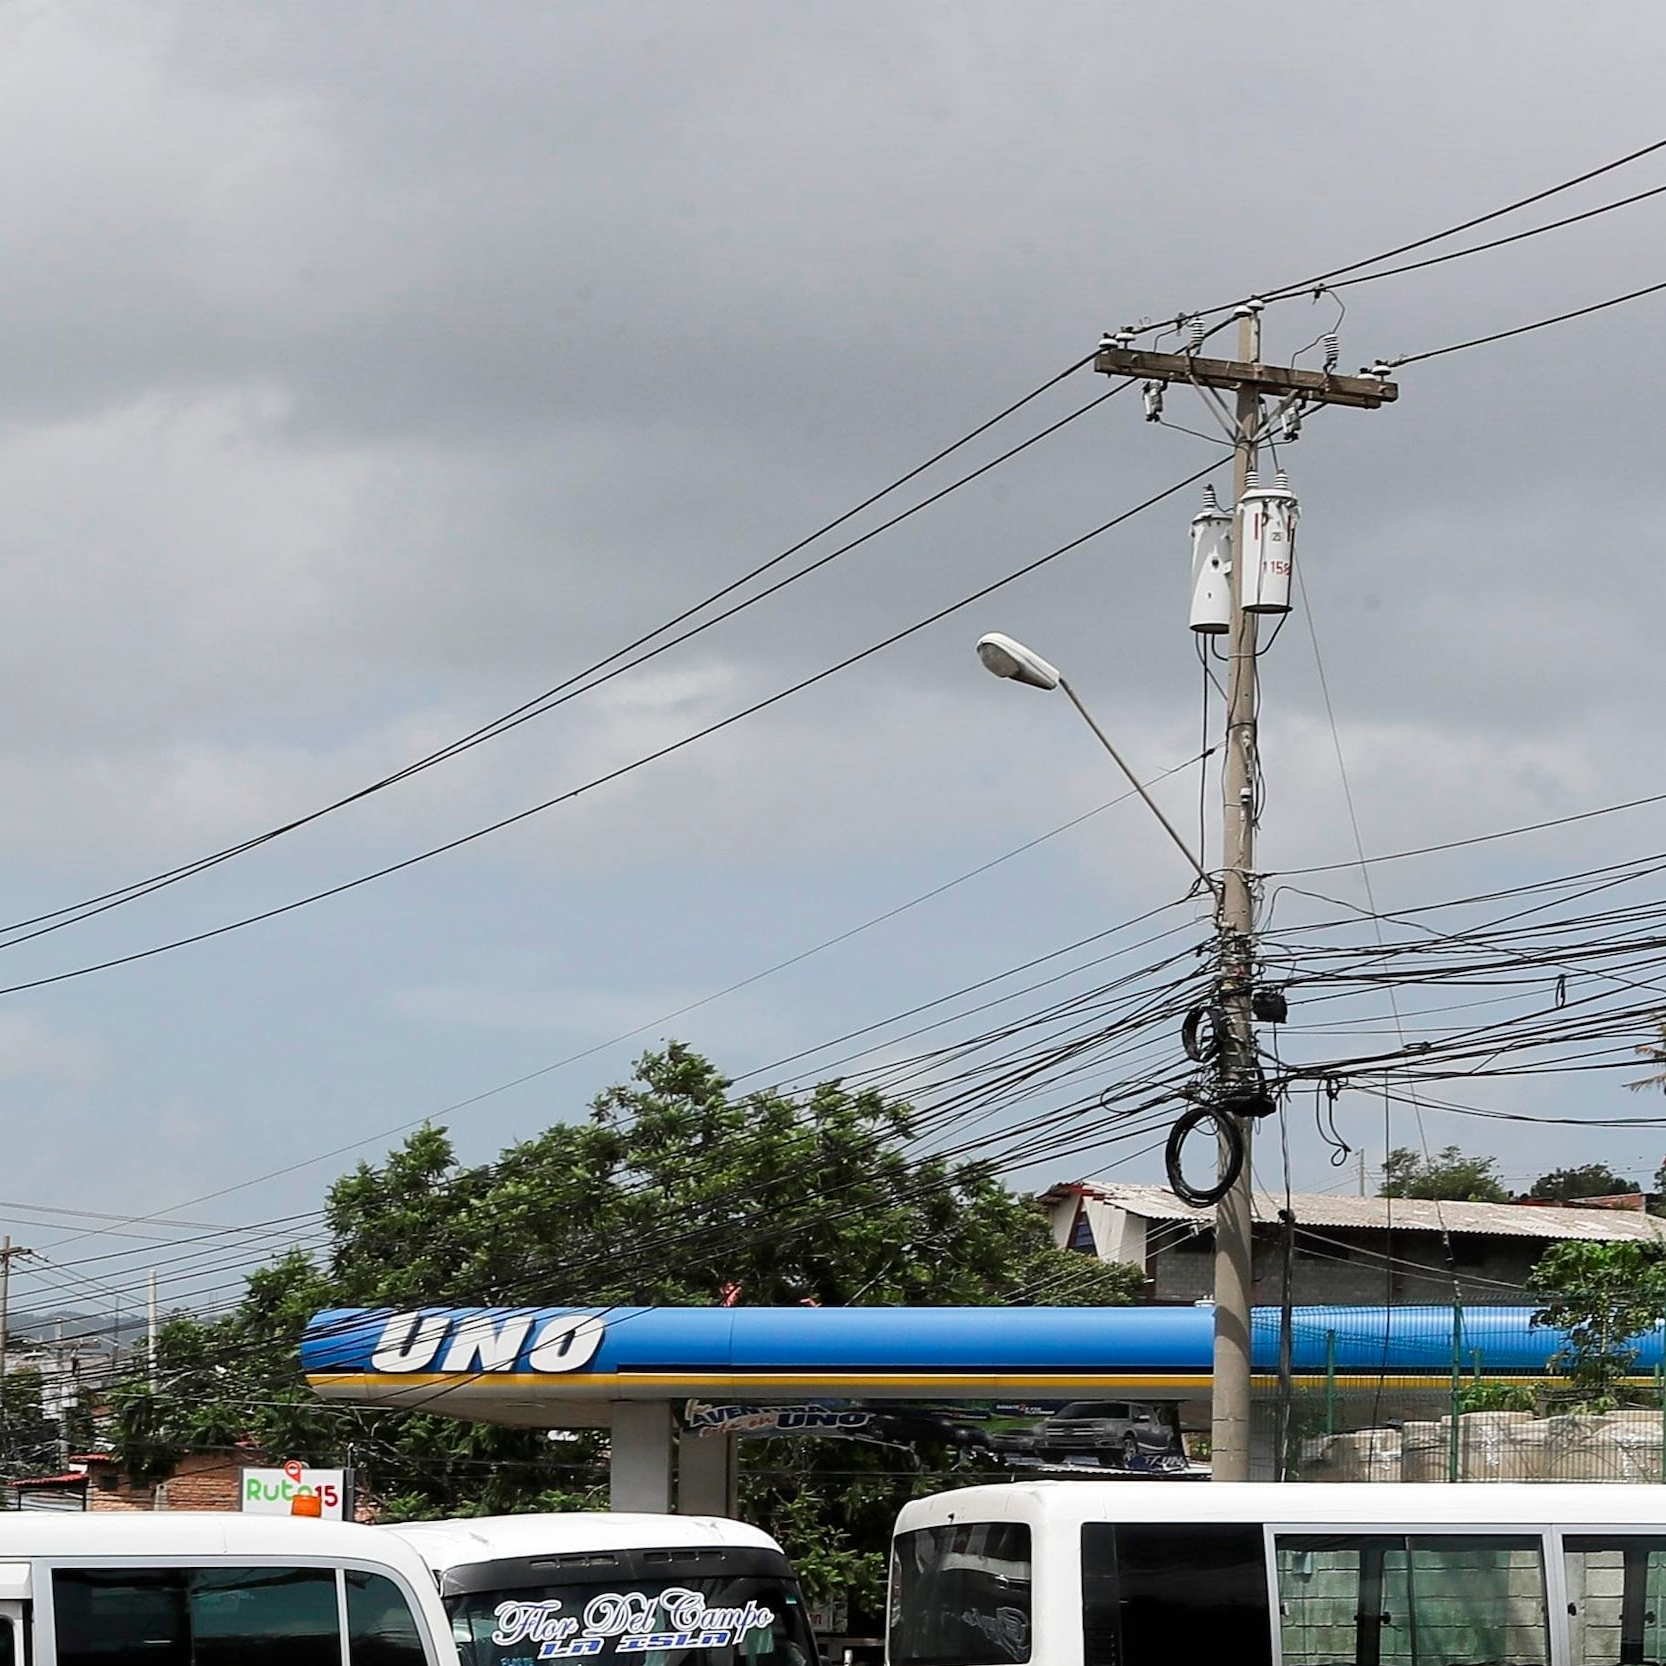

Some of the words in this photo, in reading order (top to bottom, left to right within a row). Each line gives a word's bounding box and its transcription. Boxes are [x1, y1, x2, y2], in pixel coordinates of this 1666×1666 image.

[371, 1310, 606, 1374] UNO
[776, 1413, 869, 1429] UNO
[493, 1600, 580, 1646] Flor
[582, 1592, 659, 1637] Del
[659, 1587, 776, 1645] Campo
[537, 1637, 605, 1660] LA
[615, 1630, 729, 1654] ISLA
